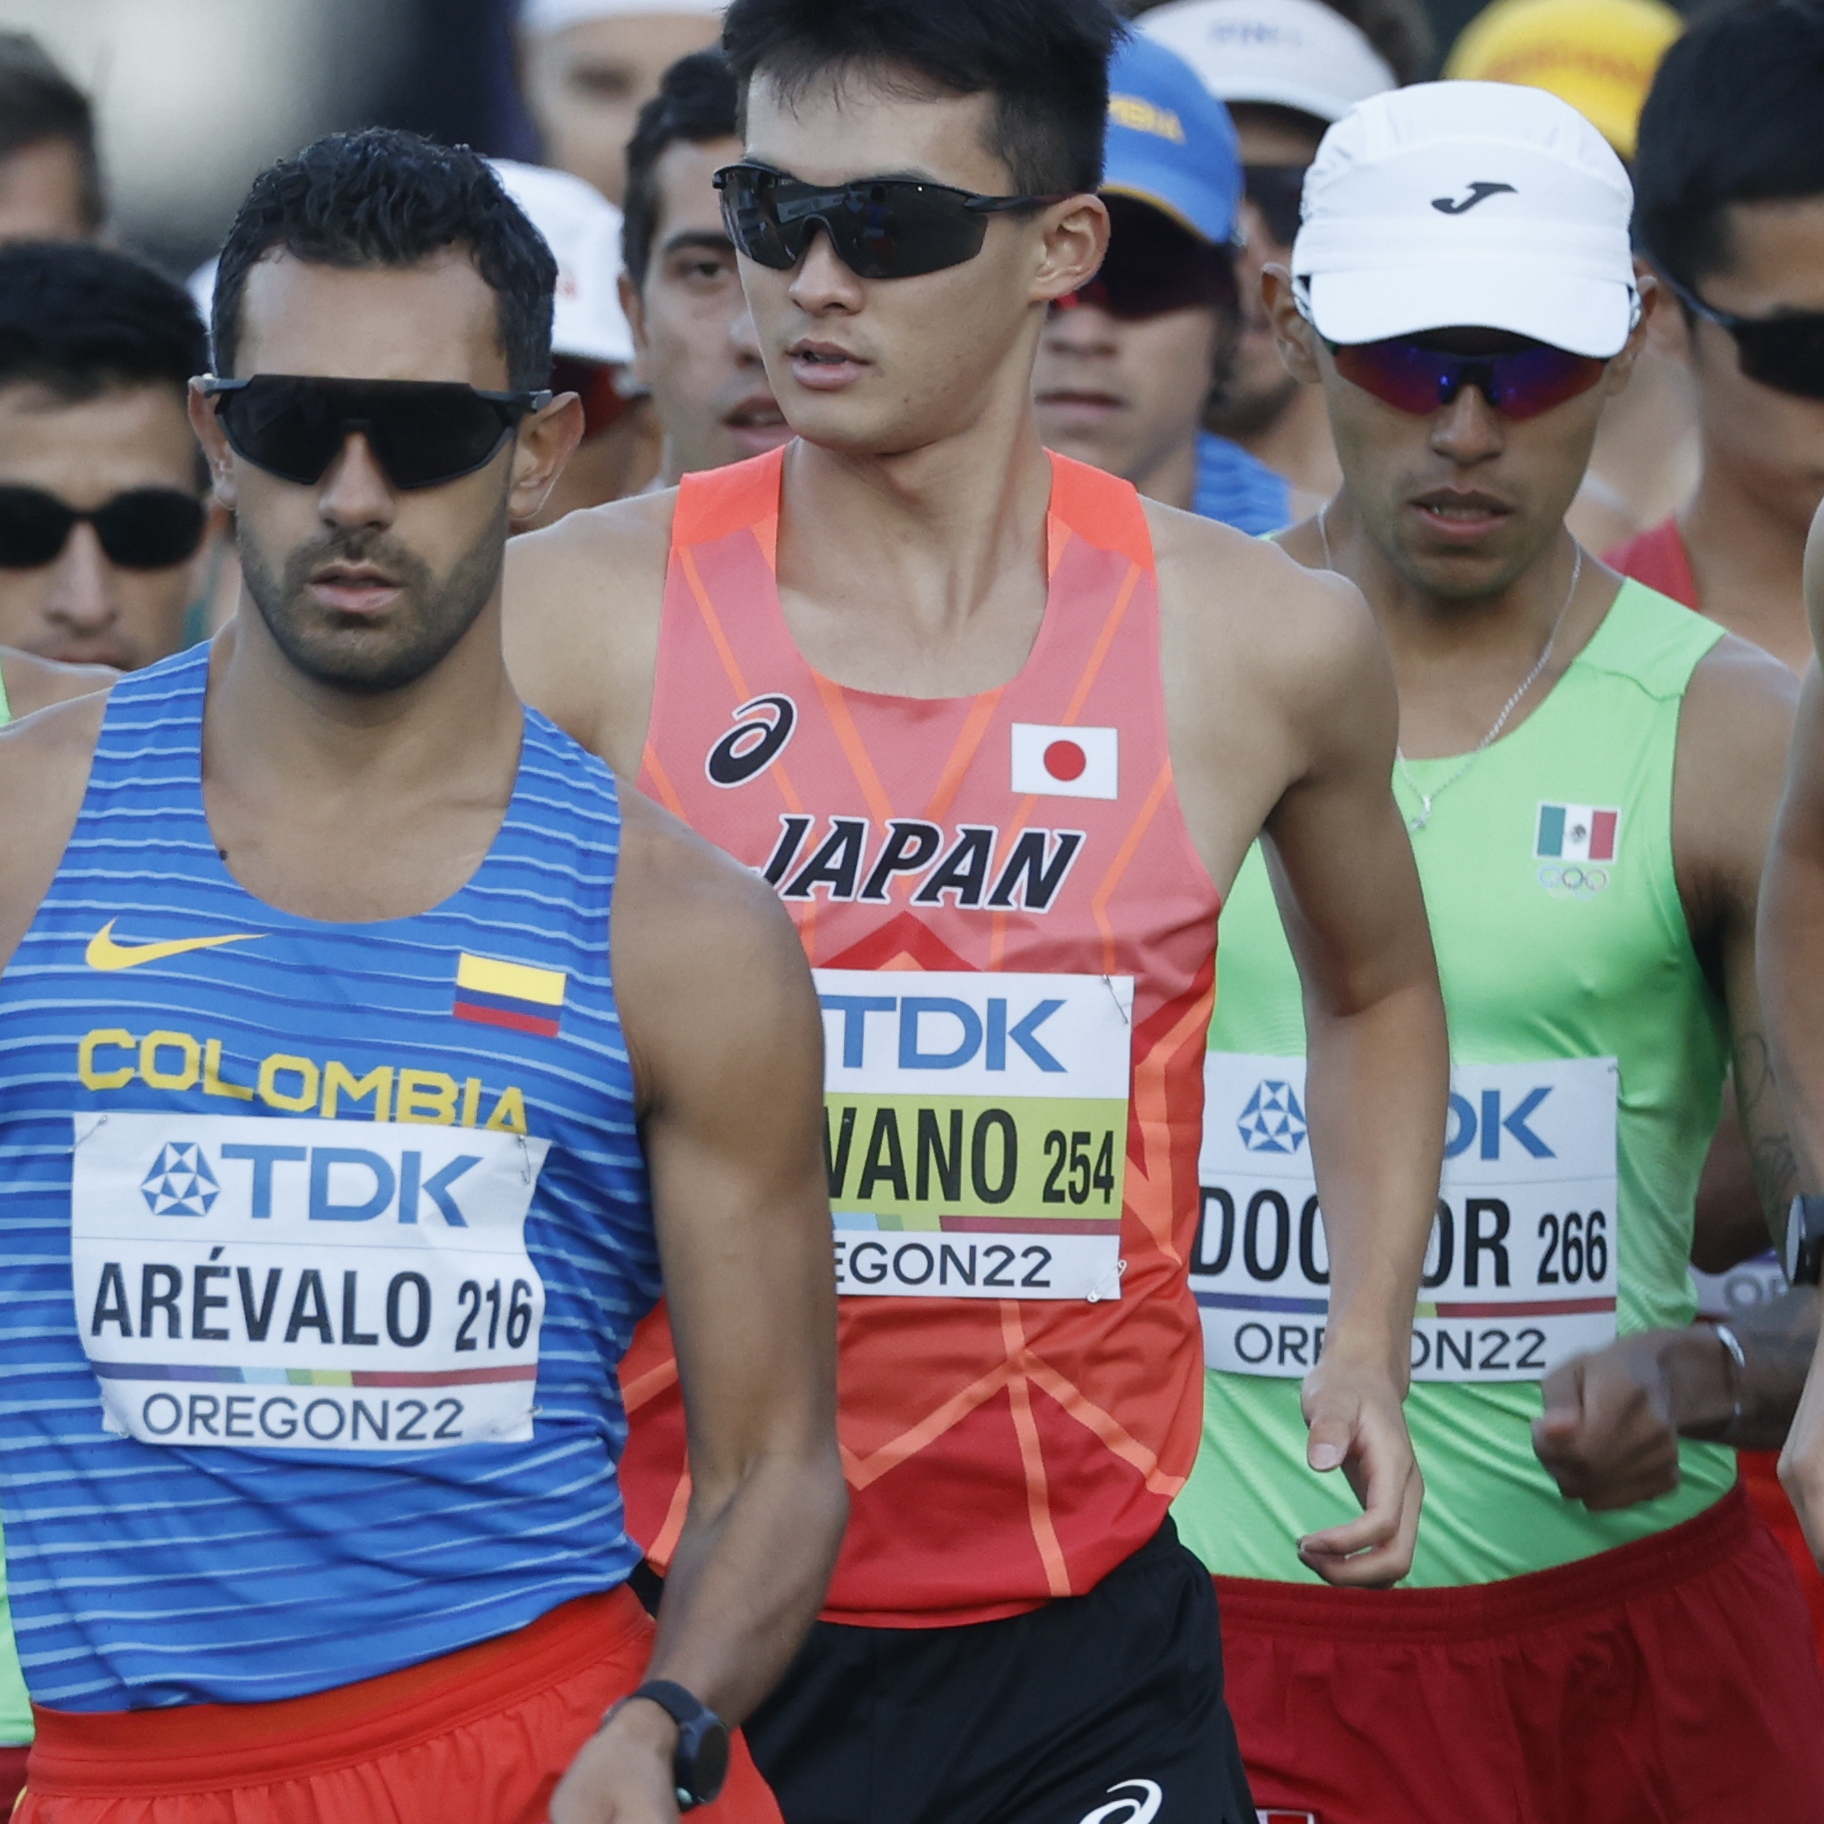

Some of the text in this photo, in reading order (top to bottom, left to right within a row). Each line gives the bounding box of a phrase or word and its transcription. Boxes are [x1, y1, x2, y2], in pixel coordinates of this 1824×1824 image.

[748, 815, 1086, 913] JAPAN
[819, 995, 1069, 1074] TDK
[78, 1027, 527, 1134] COLOMBIA
[221, 1143, 484, 1228] TDK
[1042, 1129, 1115, 1205] 254
[1537, 1209, 1608, 1285] 266
[90, 1246, 533, 1353] ARÉVALO 216
[1234, 1321, 1547, 1371] ORON22
[141, 1392, 464, 1441] OREGON22
